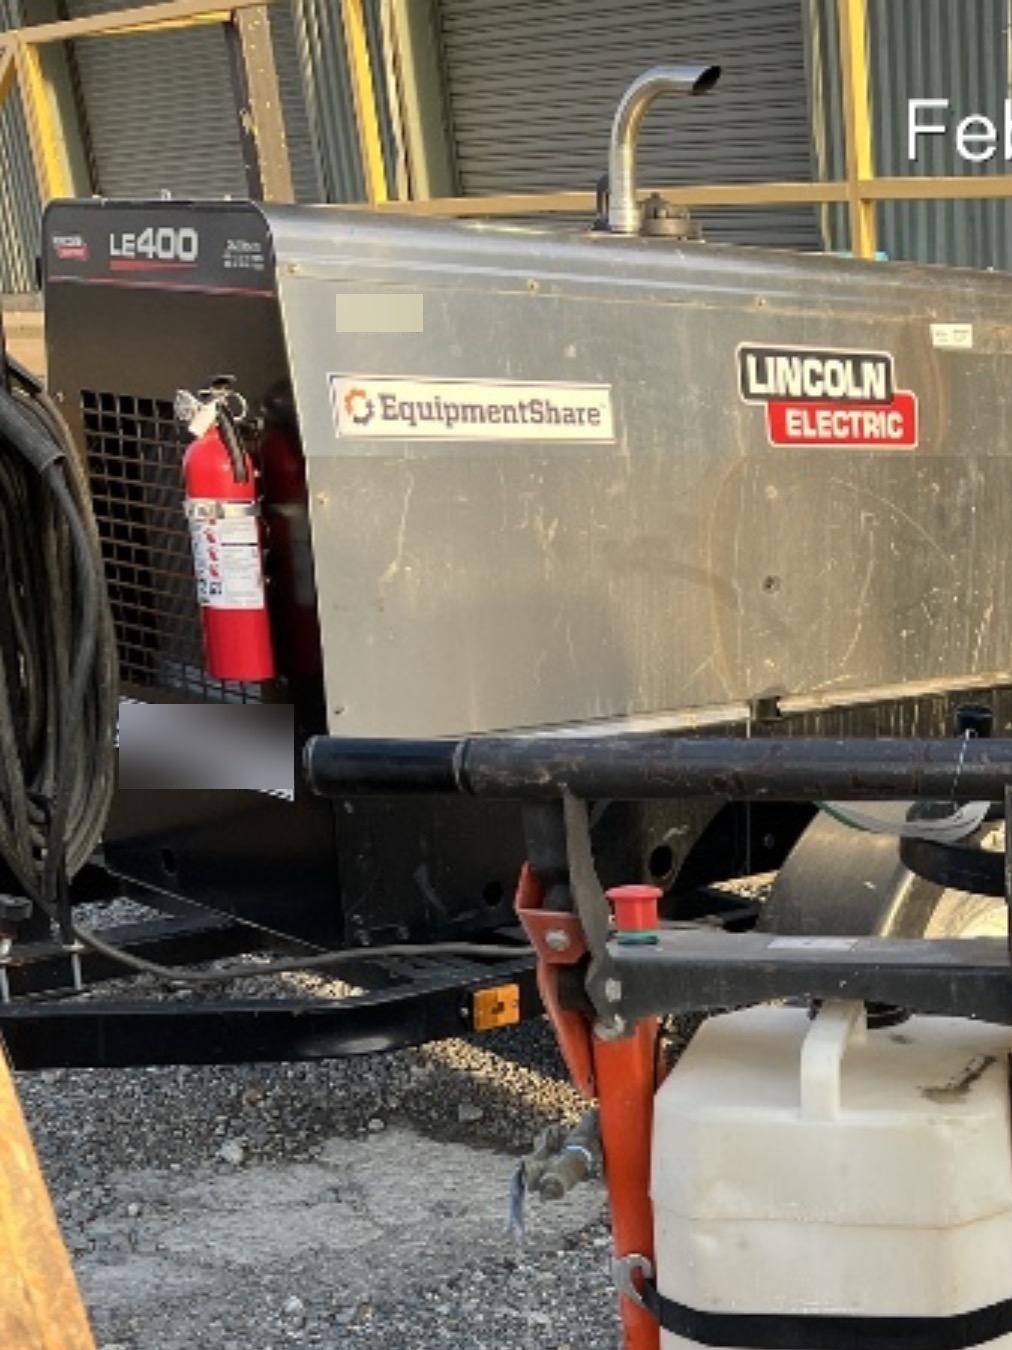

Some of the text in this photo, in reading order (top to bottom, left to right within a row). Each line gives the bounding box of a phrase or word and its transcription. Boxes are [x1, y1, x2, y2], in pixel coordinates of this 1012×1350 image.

[109, 227, 199, 263] LE400
[745, 353, 887, 400] LINCOLN
[378, 393, 601, 428] EquipmentShare
[784, 408, 905, 440] ELECTRIC
